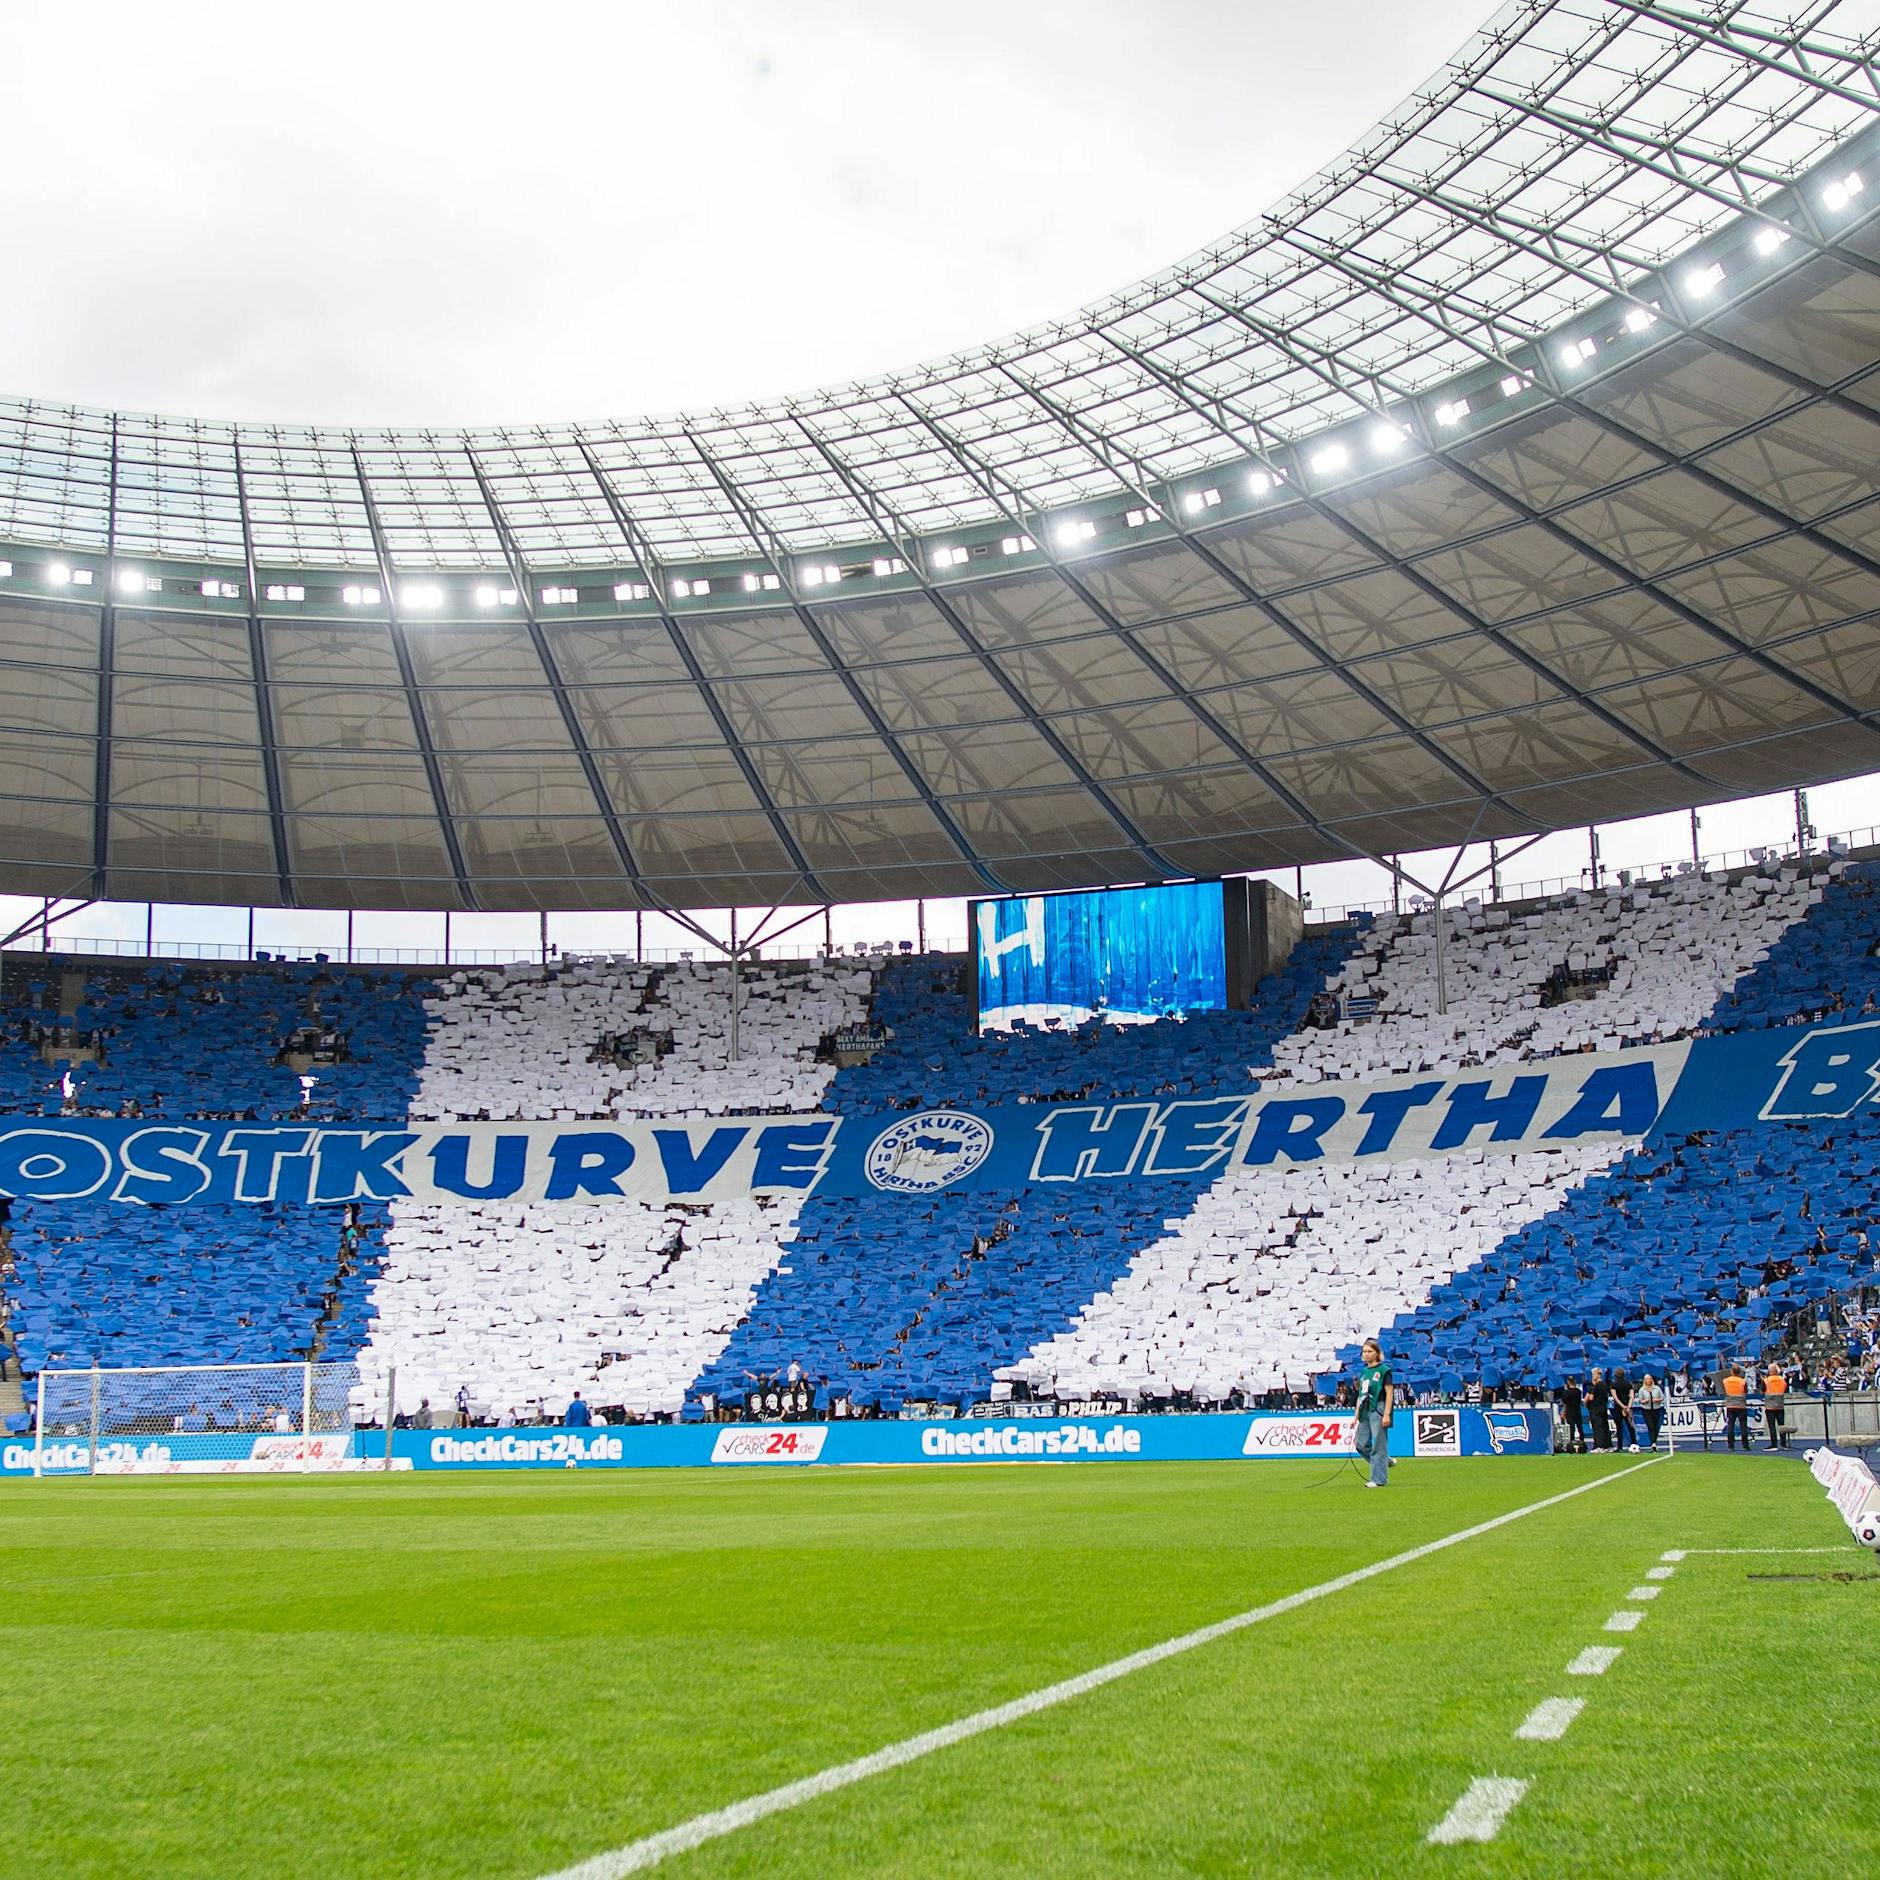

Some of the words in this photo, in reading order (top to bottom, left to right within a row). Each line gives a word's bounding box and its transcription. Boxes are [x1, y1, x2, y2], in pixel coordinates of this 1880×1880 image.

[0, 1116, 843, 1204] OSTKURVE
[1029, 1061, 1659, 1182] HERTHA
[1757, 1020, 1880, 1120] B
[882, 1118, 983, 1149] OSTKURVE
[878, 1153, 892, 1162] 18
[739, 1433, 769, 1444] check
[921, 1425, 1141, 1455] CheckCars24.de
[1274, 1424, 1309, 1436] check
[430, 1434, 623, 1462] CheckCars24.de
[734, 1443, 765, 1455] CARS
[1269, 1434, 1304, 1447] CARS
[3, 1442, 171, 1469] ChckCas24.de
